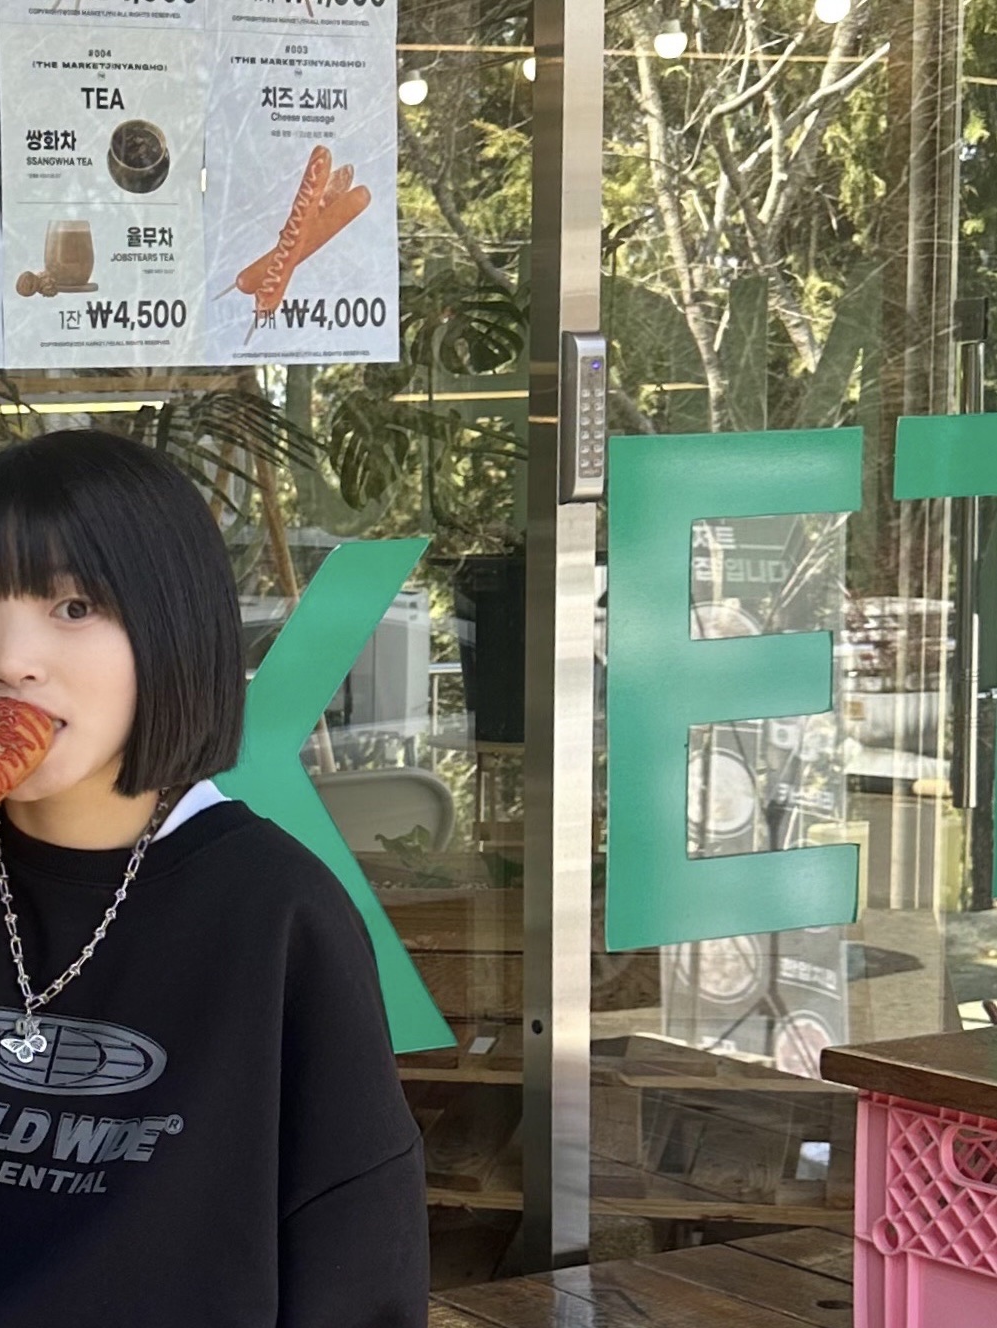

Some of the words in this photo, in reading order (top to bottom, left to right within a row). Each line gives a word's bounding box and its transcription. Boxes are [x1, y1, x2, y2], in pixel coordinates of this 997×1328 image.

[88, 49, 112, 58] #004
[285, 45, 309, 54] #003
[80, 87, 125, 110] TEA
[261, 86, 294, 109] 치즈
[299, 88, 348, 110] 소세지
[270, 111, 300, 122] Cheese
[301, 114, 335, 126] sausage
[25, 129, 77, 151] 쌍화차
[26, 156, 75, 166] SSANGWHA
[77, 157, 93, 167] TEA
[127, 226, 174, 248] 율무차
[110, 252, 158, 262] JOBSTEARS
[159, 253, 175, 262] TEA
[58, 309, 82, 330] 1잔
[252, 309, 276, 330] 1개
